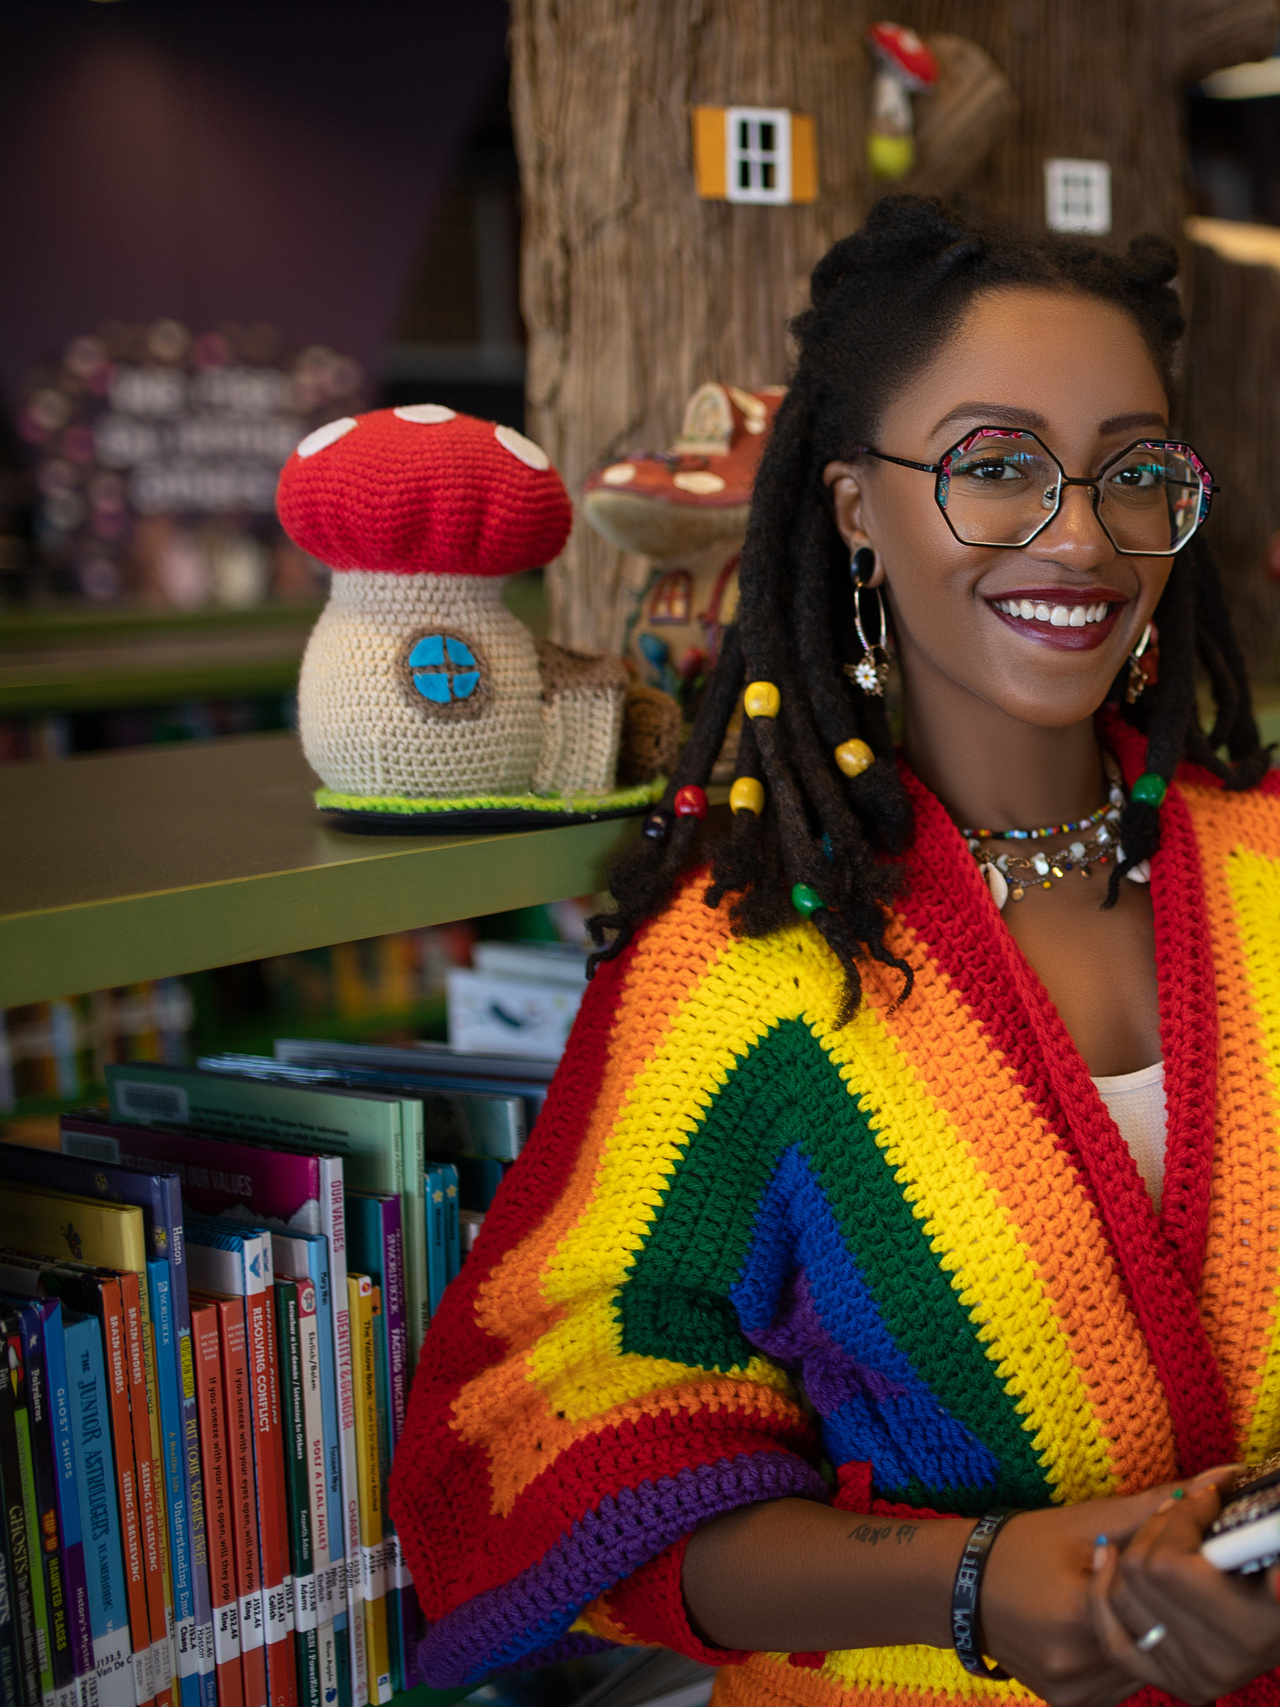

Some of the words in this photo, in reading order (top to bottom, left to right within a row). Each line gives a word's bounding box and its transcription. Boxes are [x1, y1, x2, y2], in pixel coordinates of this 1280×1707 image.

[330, 1180, 343, 1204] OUR
[331, 1206, 344, 1253] VALUES
[172, 1226, 185, 1265] Hasson
[110, 1315, 121, 1348] BRAIN
[128, 1307, 139, 1341] BRAIN
[336, 1309, 350, 1367] IDENTITY
[253, 1307, 266, 1373] RESOLVING
[80, 1350, 91, 1374] THE
[113, 1350, 125, 1395] BENDERS
[131, 1342, 143, 1386] BENDERS
[235, 1367, 243, 1376] If
[309, 1331, 318, 1391] Ehrlich/Bolam
[208, 1387, 217, 1401] you
[209, 1376, 217, 1385] If
[235, 1378, 244, 1392] you
[31, 1368, 42, 1423] Polydoros
[256, 1376, 270, 1434] CONFLICT
[340, 1379, 354, 1430] GENDER
[56, 1388, 69, 1433] GHOST
[77, 1376, 103, 1447] JUNIOR
[211, 1405, 219, 1439] sneeze
[237, 1395, 246, 1430] sneeze
[186, 1418, 197, 1441] PUT
[239, 1431, 248, 1453] with
[62, 1439, 73, 1479] SHIPS
[188, 1444, 201, 1479] YOUR
[213, 1441, 223, 1463] with
[239, 1455, 249, 1476] your
[141, 1461, 153, 1501] SEEING
[213, 1464, 223, 1486] your
[241, 1479, 250, 1500] eyes
[315, 1471, 322, 1480] A
[122, 1470, 135, 1510] SEEING
[216, 1488, 225, 1510] eyes
[126, 1511, 135, 1521] IS
[145, 1501, 154, 1511] IS
[243, 1502, 252, 1528] open,
[43, 1510, 56, 1535] TOP
[217, 1512, 227, 1538] open,
[8, 1504, 29, 1575] GHOSTS
[45, 1536, 57, 1552] 10
[127, 1522, 140, 1583] BELIEVING
[146, 1511, 158, 1572] BELIEVING
[174, 1500, 188, 1589] Understanding
[194, 1535, 207, 1566] AWAY
[220, 1540, 229, 1558] will
[245, 1530, 254, 1548] will
[220, 1559, 231, 1581] they
[245, 1549, 255, 1571] they
[49, 1557, 63, 1608] HAUNTED
[97, 1542, 114, 1612] HANDBOOK
[222, 1582, 231, 1601] pop
[246, 1573, 254, 1591] pop
[317, 1573, 326, 1603] Ehrlich
[76, 1587, 87, 1633] History's
[244, 1601, 252, 1621] King
[300, 1584, 308, 1612] Adams
[221, 1611, 229, 1632] King
[229, 1609, 238, 1640] J152.46
[253, 1598, 261, 1629] J152.46
[54, 1610, 68, 1652] PLACES
[180, 1626, 188, 1654] Chang
[189, 1623, 198, 1650] J152.4
[197, 1628, 205, 1659] Hasson
[96, 1650, 122, 1669] J133.5
[97, 1665, 113, 1678] Van
[114, 1660, 126, 1671] De
